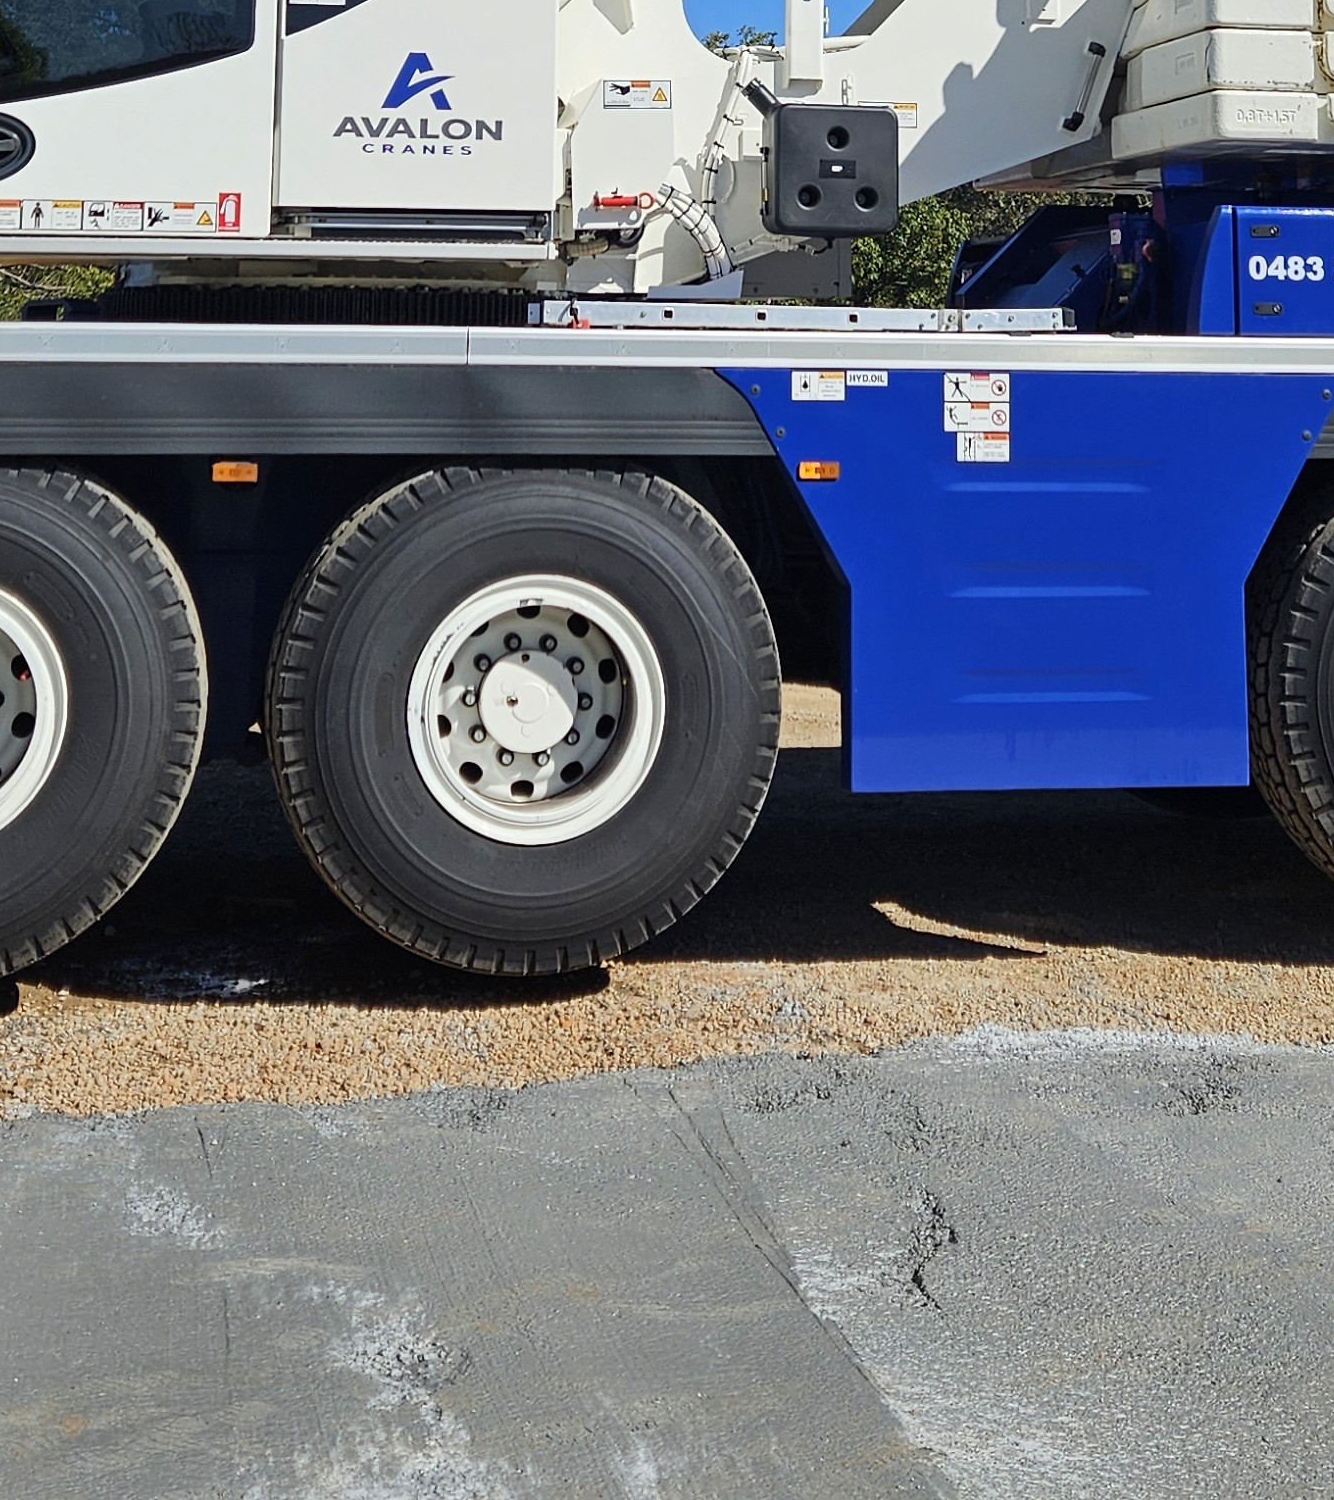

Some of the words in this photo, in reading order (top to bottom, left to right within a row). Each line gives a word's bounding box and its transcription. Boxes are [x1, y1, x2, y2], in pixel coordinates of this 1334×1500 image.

[333, 117, 503, 140] AVALON
[361, 143, 472, 155] CRANES
[1248, 256, 1325, 282] 0483
[849, 374, 885, 383] HYD.OIL
